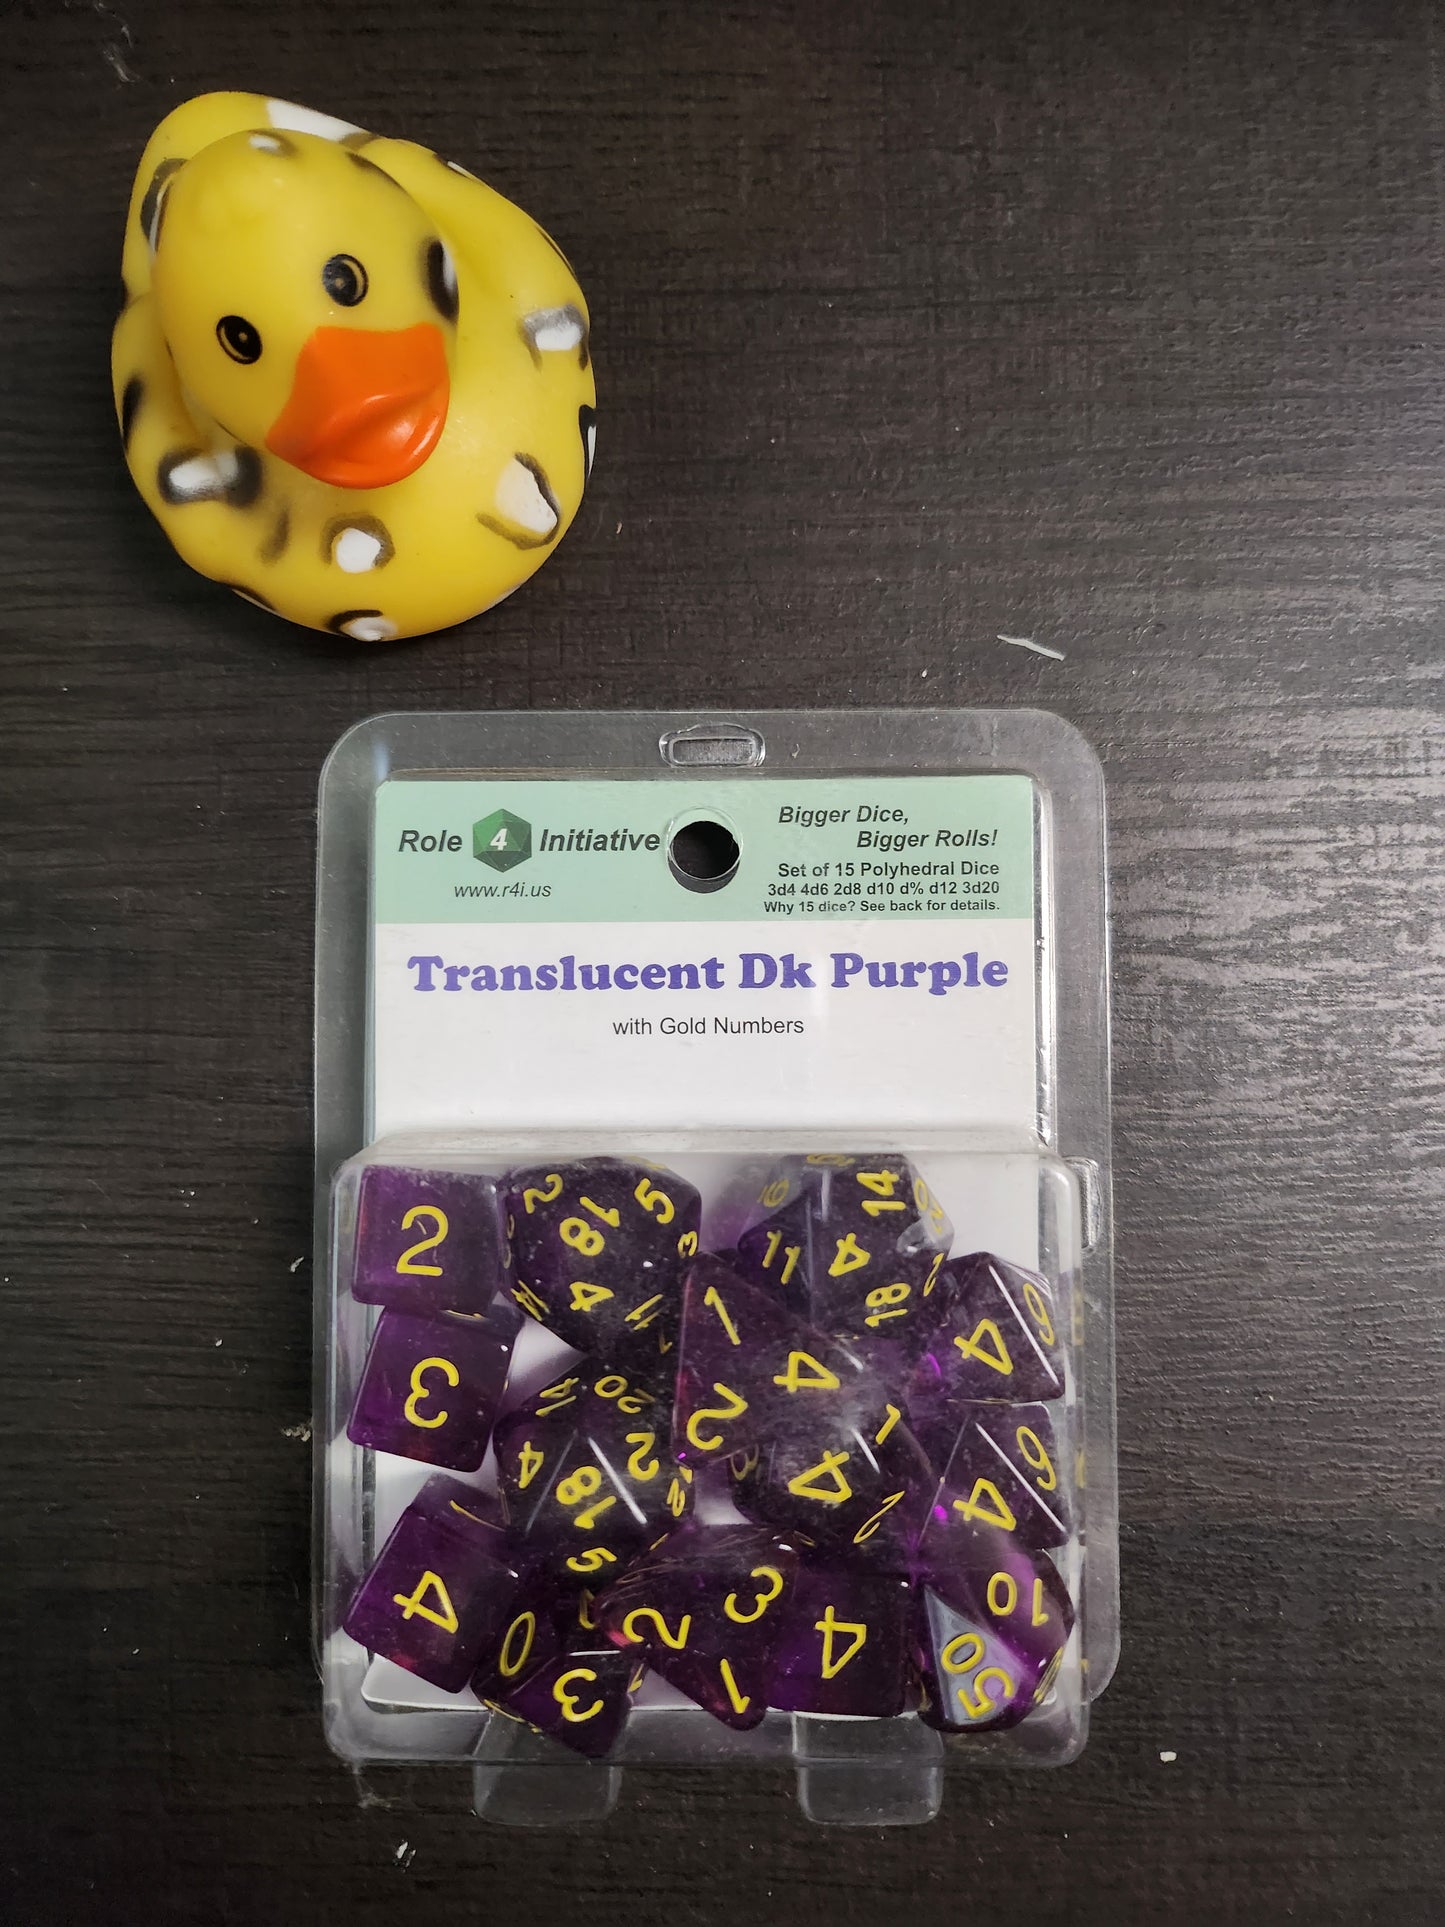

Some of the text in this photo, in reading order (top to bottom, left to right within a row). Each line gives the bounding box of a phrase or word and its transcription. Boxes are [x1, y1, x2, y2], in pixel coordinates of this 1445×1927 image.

[398, 826, 660, 852] Role 4 Initiative
[778, 805, 908, 827] Bigger Dice,
[857, 829, 998, 852] Bigger Rolls!
[454, 882, 551, 897] www.r4i.us
[768, 881, 999, 896] 3d4 4d6 2d8 d10 d% d12 3d20
[778, 861, 999, 879] Set of 15 Polyhedral Dice
[764, 899, 1000, 915] Why 15 dice? See back for details.
[407, 952, 1008, 995] Translucent Dk Purple
[613, 1017, 804, 1035] with Gold Numbers
[523, 1172, 564, 1214] 2
[634, 1176, 675, 1225] 5
[856, 1168, 908, 1218] 14
[396, 1205, 449, 1277] 2
[559, 1195, 622, 1258] 18
[761, 1230, 801, 1285] 11
[828, 1232, 871, 1277] 4
[569, 1281, 615, 1313] 4
[703, 1286, 741, 1346] 1
[864, 1282, 912, 1328] 18
[773, 1350, 841, 1393] 4
[953, 1318, 1014, 1376] 4
[404, 1357, 460, 1429] 3
[686, 1382, 748, 1451] 2
[874, 1403, 901, 1445] 1
[518, 1440, 545, 1489] 4
[625, 1431, 660, 1482] 2
[787, 1449, 853, 1505] 4
[555, 1465, 617, 1530] 18
[953, 1477, 1017, 1531] 4
[565, 1547, 618, 1574] 5
[394, 1570, 459, 1634] 4
[723, 1565, 784, 1624] 3
[986, 1571, 1049, 1627] 10
[499, 1611, 536, 1677] 0
[622, 1607, 692, 1650] 2
[814, 1605, 867, 1680] 4
[552, 1667, 605, 1723] 3
[719, 1658, 751, 1714] 1
[940, 1631, 1015, 1719] 50
